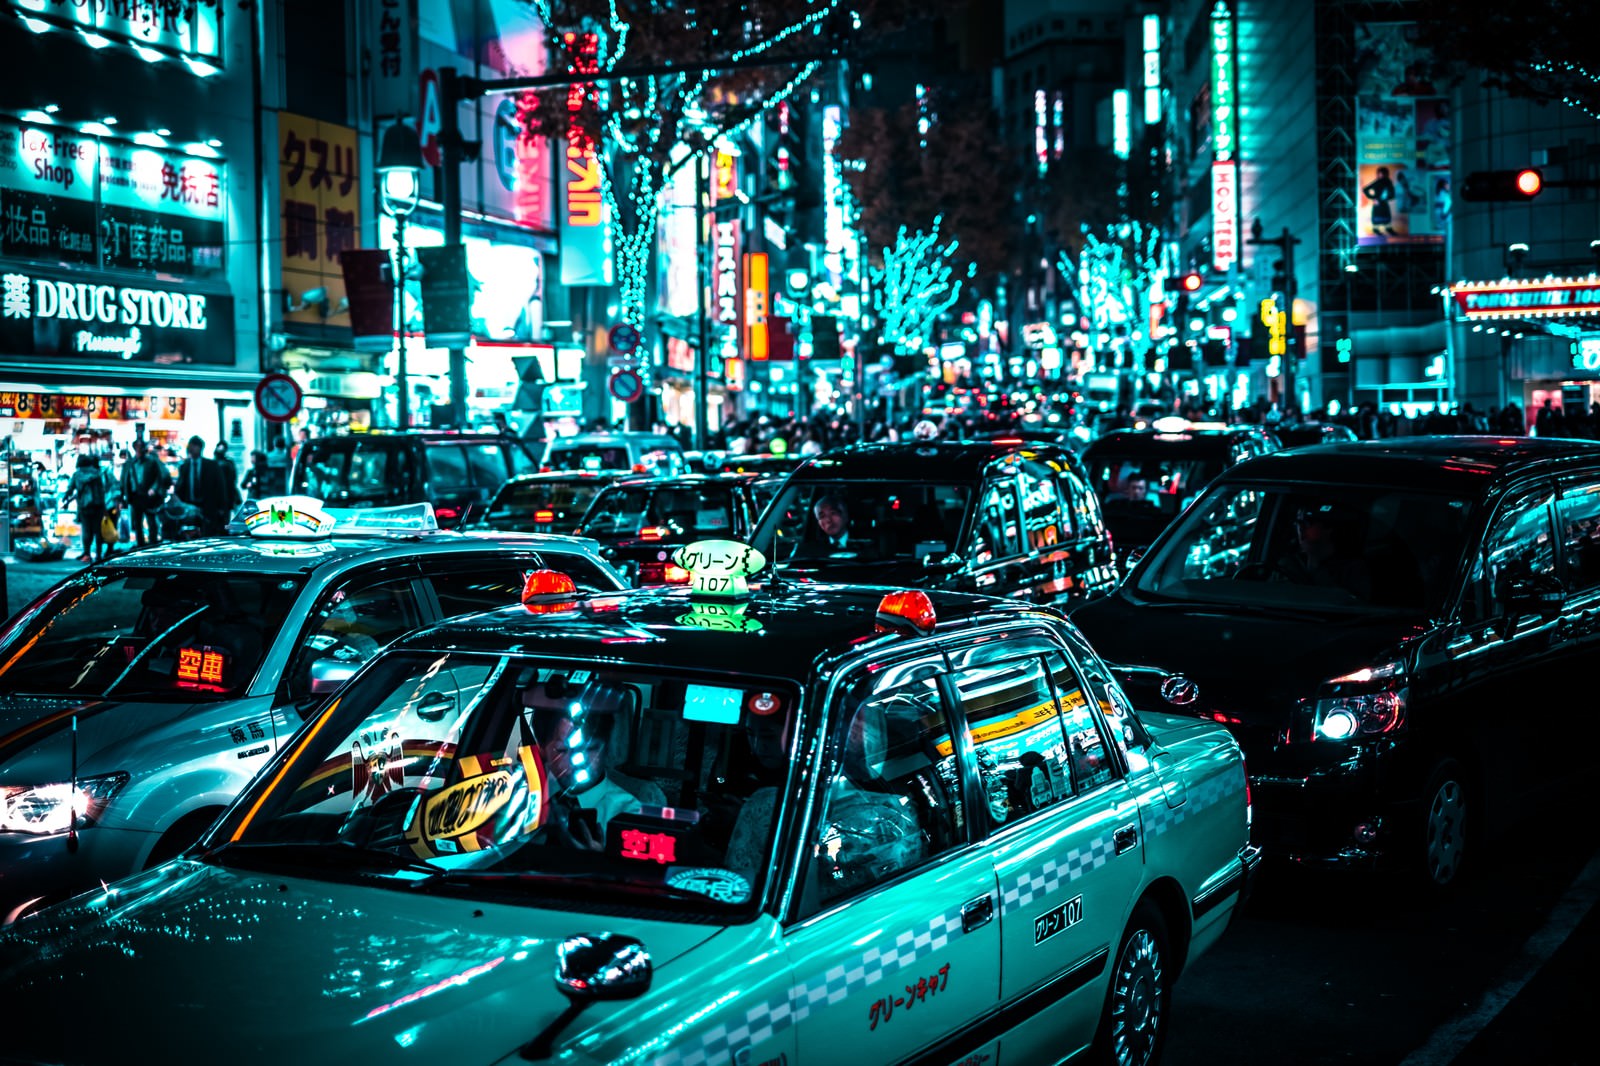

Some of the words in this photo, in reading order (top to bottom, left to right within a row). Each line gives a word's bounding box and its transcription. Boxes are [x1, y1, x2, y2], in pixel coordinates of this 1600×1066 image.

[34, 157, 74, 191] Shop
[284, 129, 353, 197] クスリ
[1215, 173, 1233, 258] HOOTERS
[35, 279, 118, 324] DRUG
[119, 287, 208, 331] STORE
[686, 552, 738, 570] グリーン
[700, 577, 729, 592] 107
[178, 648, 223, 682] 空車
[1036, 914, 1060, 940] グリーン
[1062, 897, 1081, 927] 107
[869, 963, 950, 1031] グリーンキャブ
